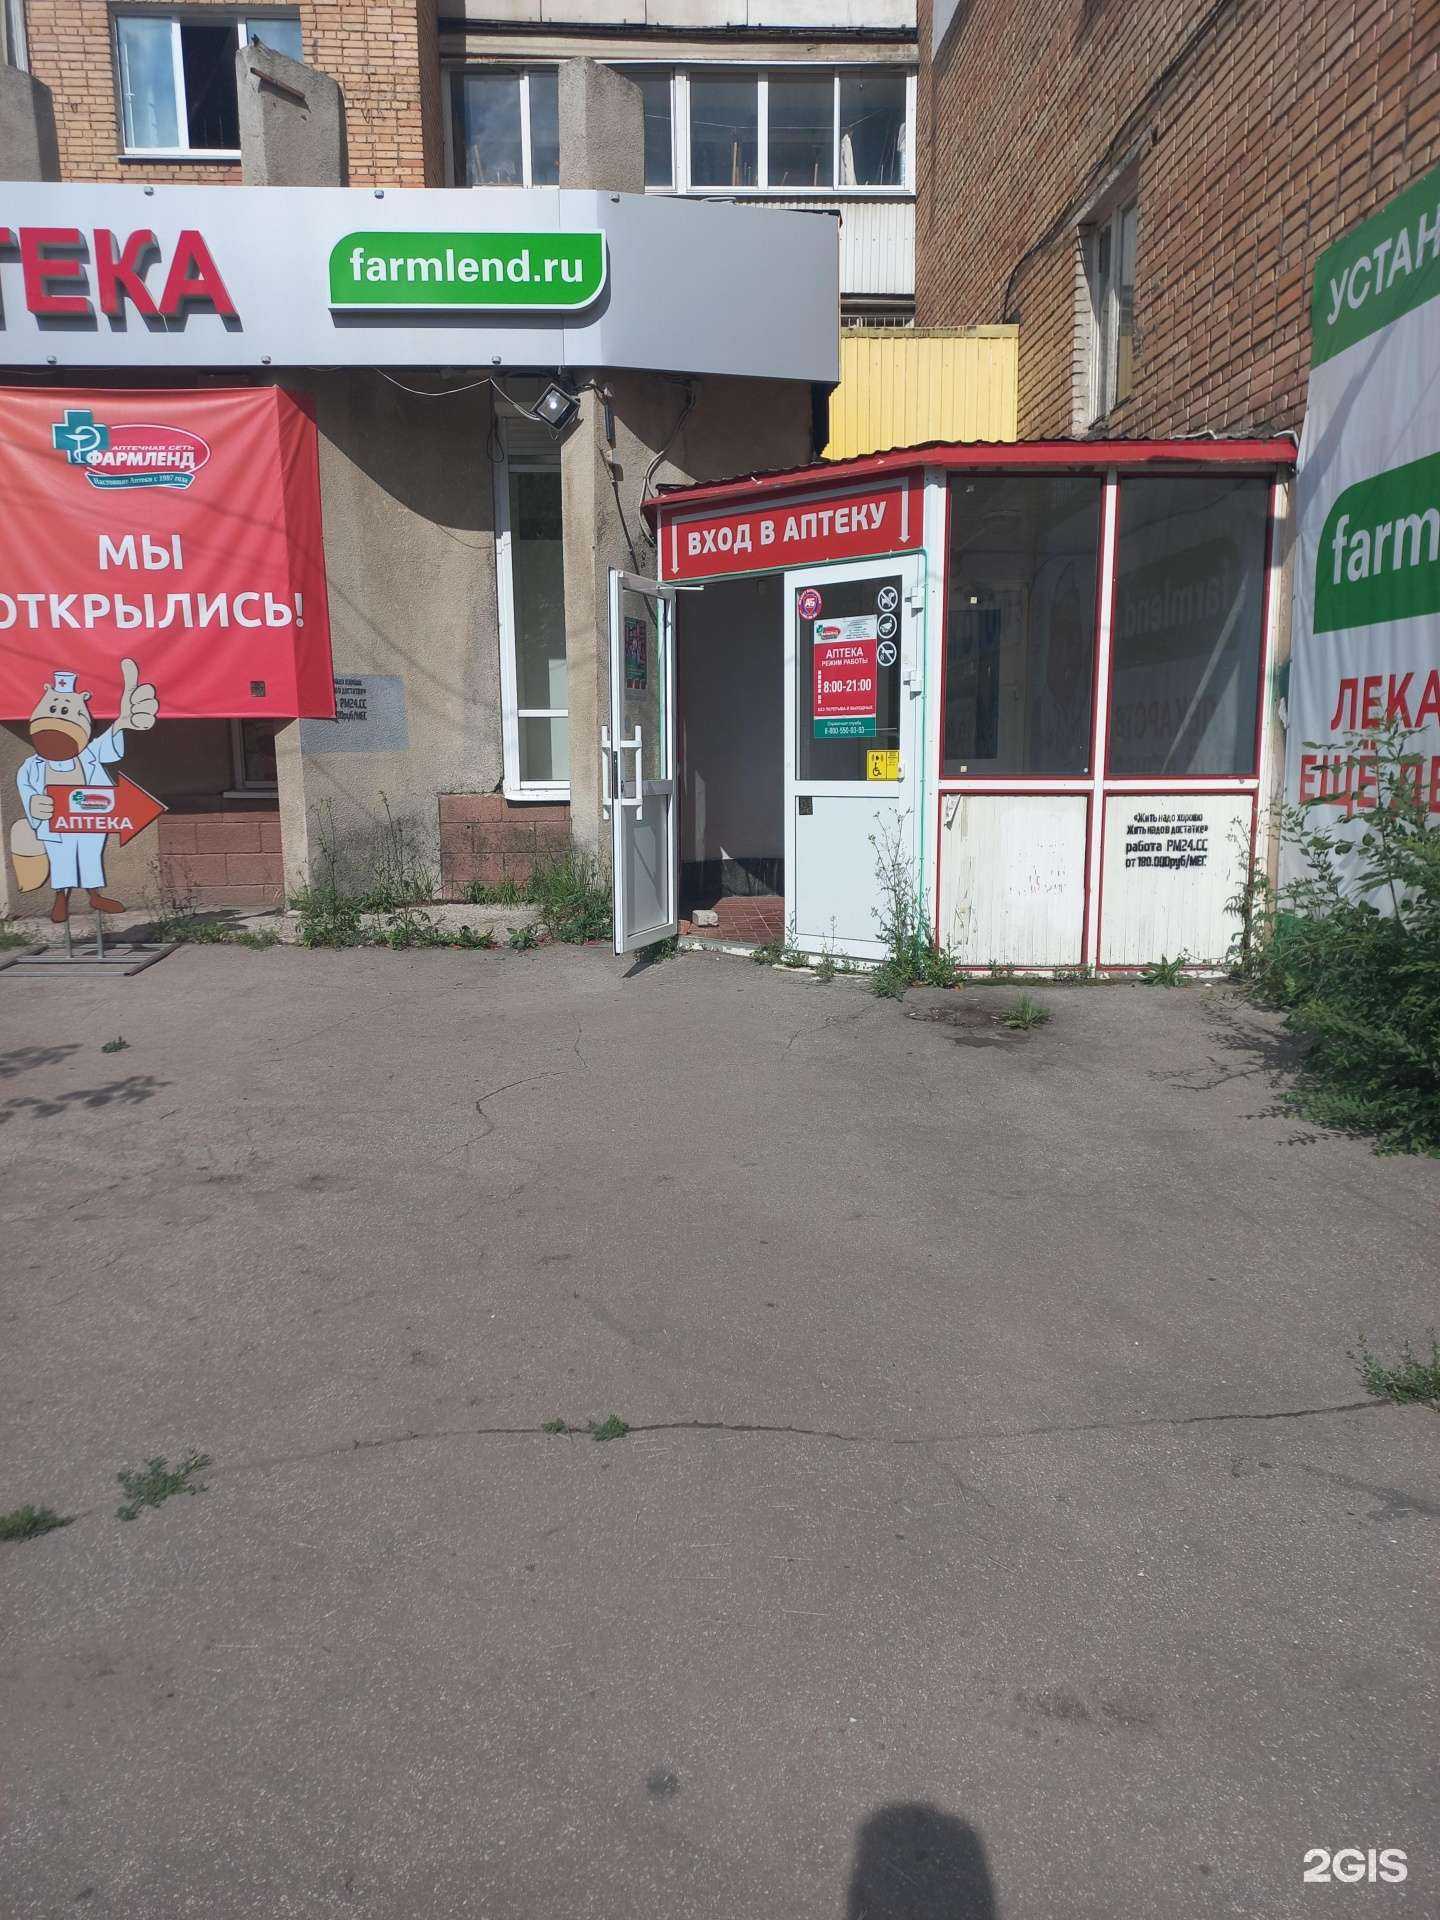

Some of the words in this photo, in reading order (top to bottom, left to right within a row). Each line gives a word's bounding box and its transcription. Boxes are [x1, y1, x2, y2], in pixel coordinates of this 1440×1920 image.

[349, 247, 583, 283] farmlend.ru
[1327, 203, 1440, 325] УСТАН
[86, 450, 196, 469] ФАРМЛЕНД
[688, 524, 753, 556] ВХОД
[760, 520, 775, 545] В
[783, 501, 887, 543] АПТЕКУ
[98, 534, 184, 570] МЫ
[1332, 507, 1440, 585] farm
[826, 646, 864, 659] АПТЕКА
[821, 659, 843, 667] РЕЖИМ
[843, 657, 869, 665] РАБОТЫ
[823, 678, 872, 693] 8:00-21:00
[55, 816, 134, 830] АПТЕКА
[1126, 841, 1163, 855] работа
[1126, 858, 1137, 868] от
